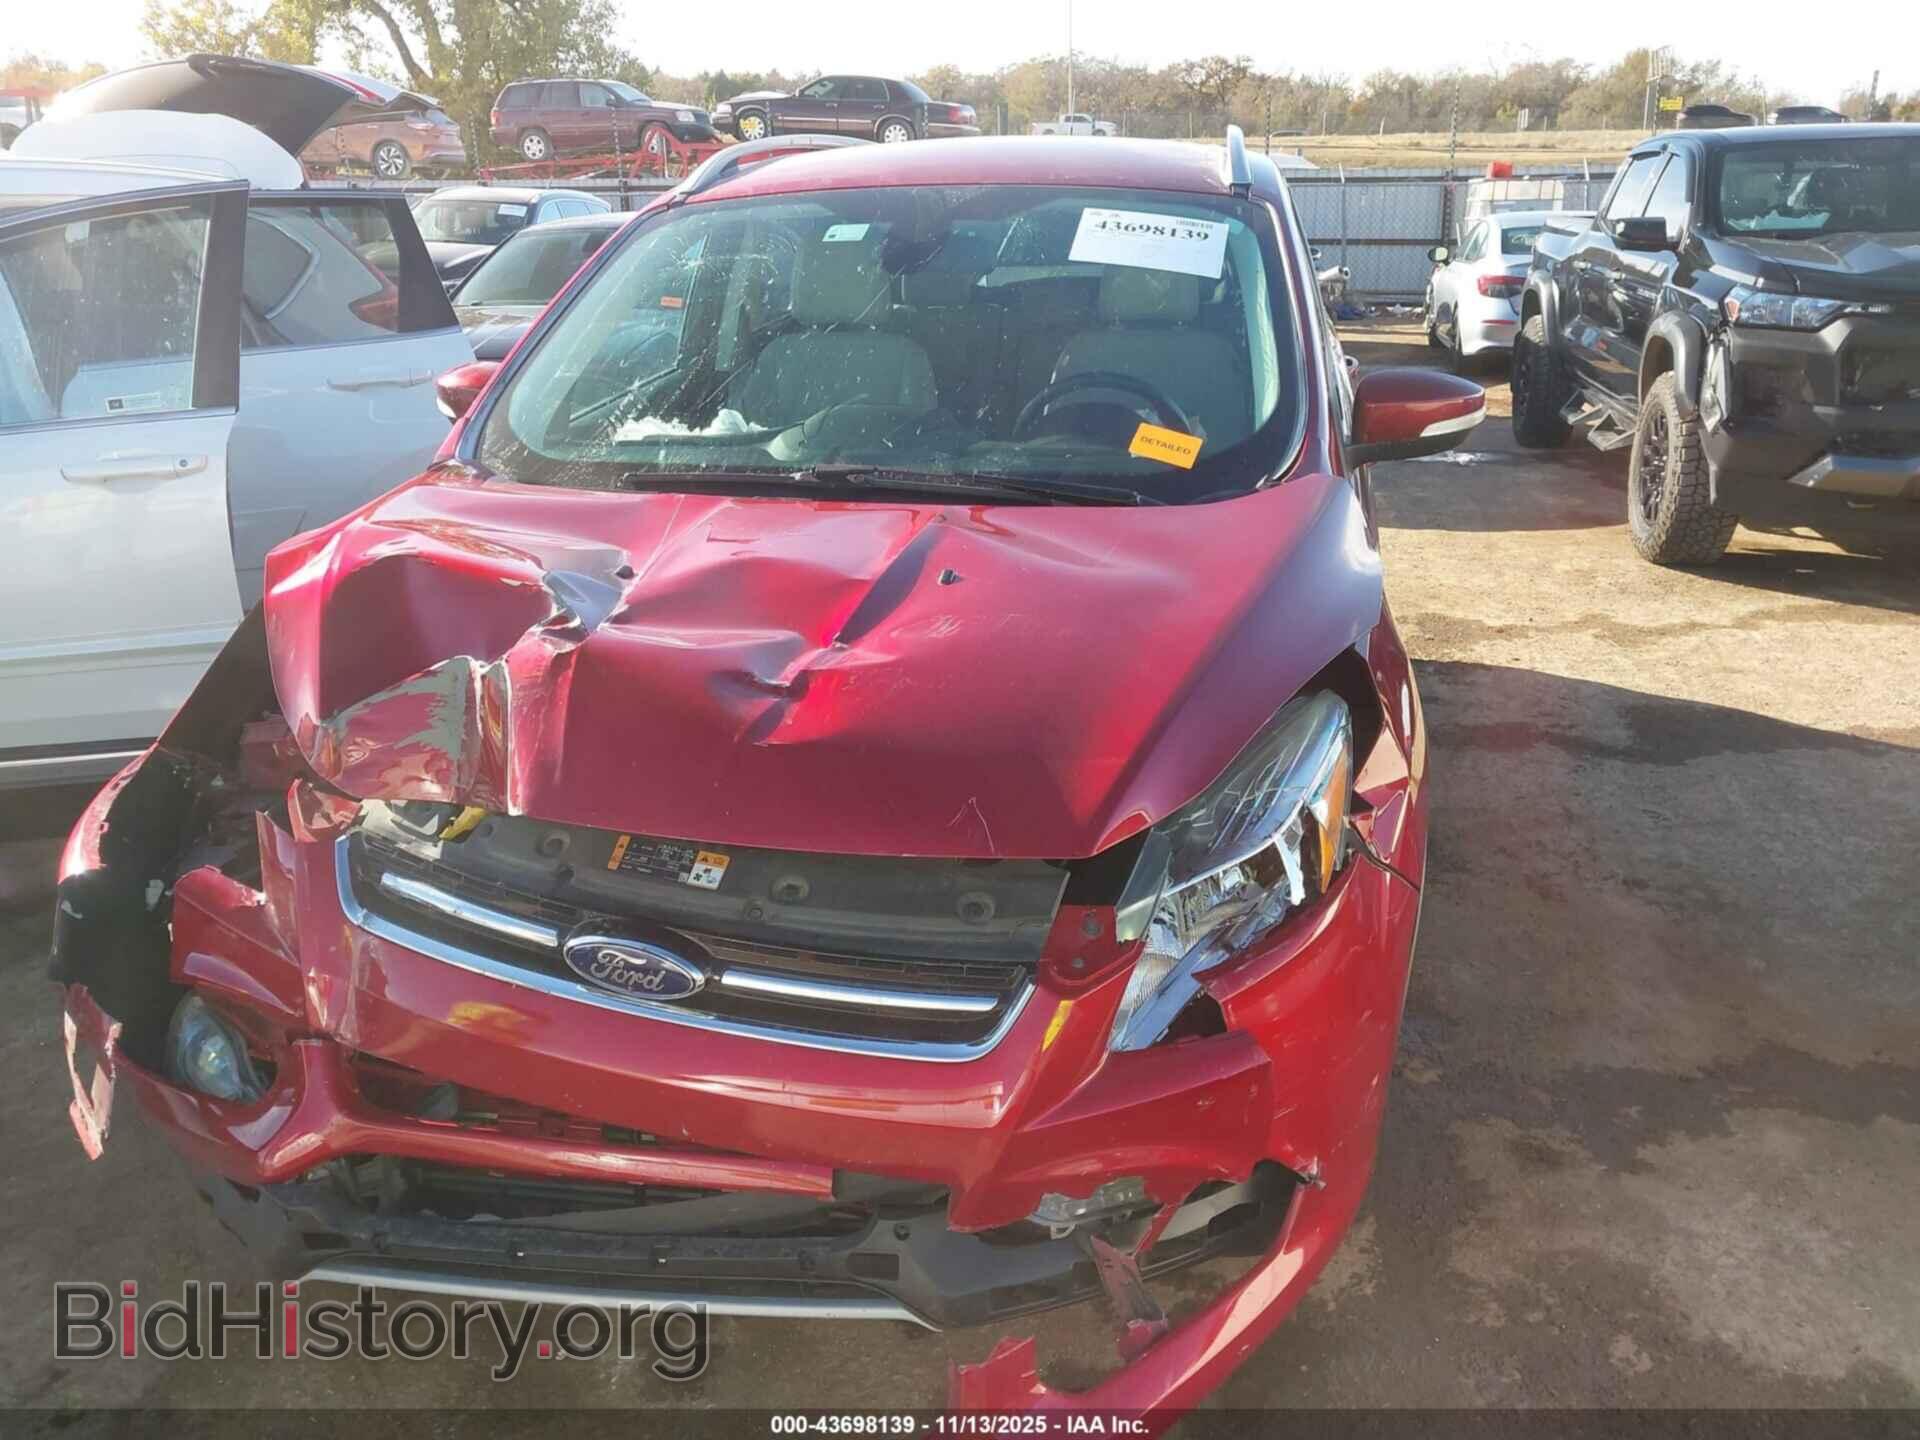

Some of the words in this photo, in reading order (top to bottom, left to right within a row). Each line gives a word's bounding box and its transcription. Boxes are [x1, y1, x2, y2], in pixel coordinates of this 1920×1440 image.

[1094, 220, 1209, 241] 43698139
[1140, 436, 1191, 455] DETAILED
[590, 950, 666, 991] Ford
